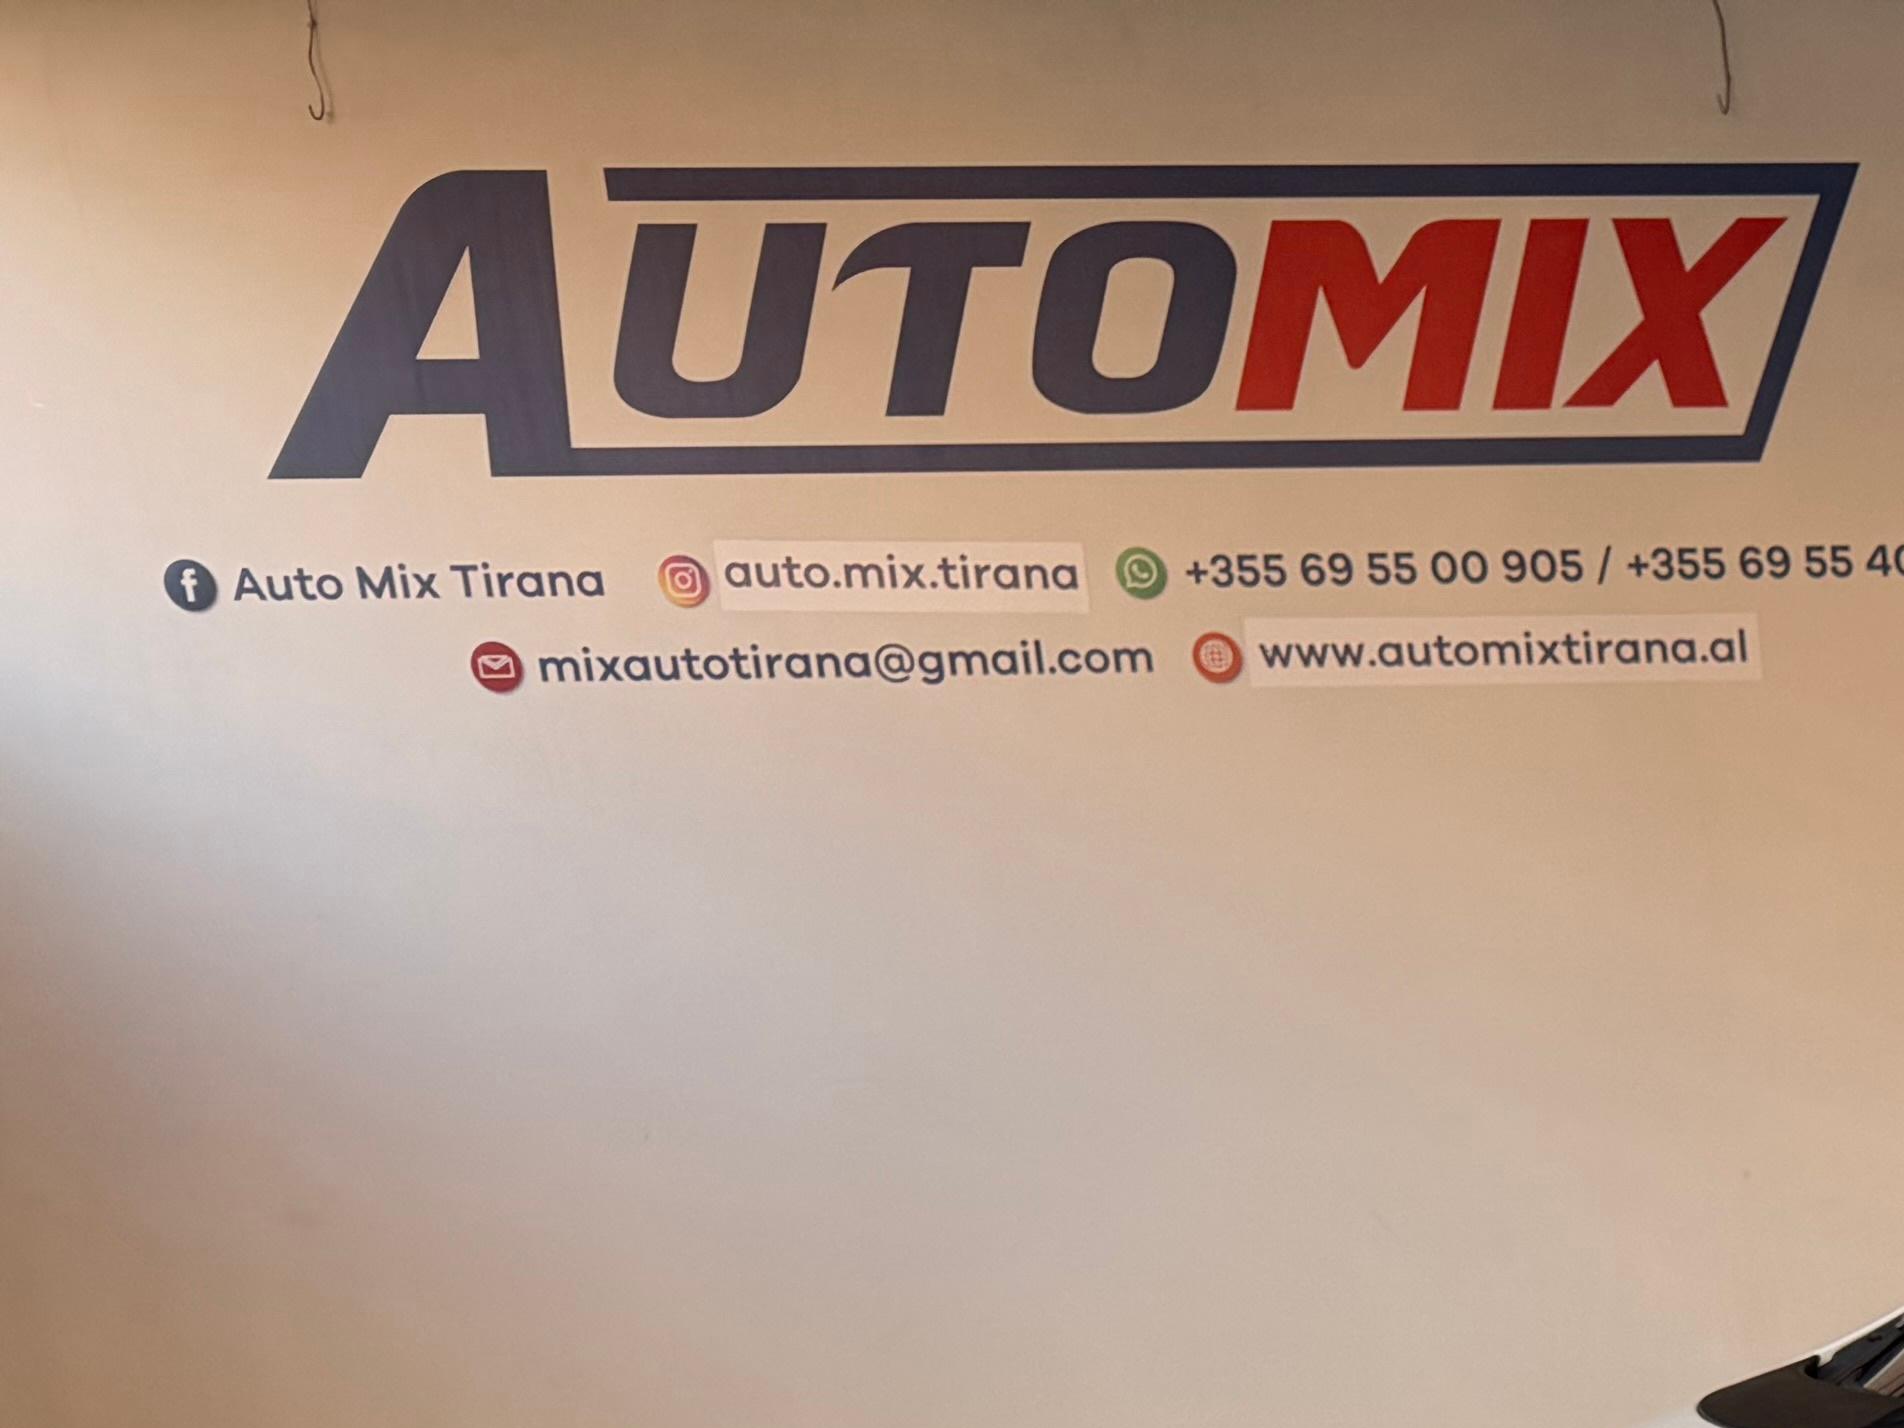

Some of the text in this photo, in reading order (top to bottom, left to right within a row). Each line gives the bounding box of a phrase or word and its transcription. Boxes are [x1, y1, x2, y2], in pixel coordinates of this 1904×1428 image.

[268, 168, 1788, 478] AUTOMIX
[234, 562, 605, 601] Auto Mix Tirana
[724, 553, 1079, 591] auto.mix.tirana
[1186, 553, 1287, 587] +355
[1300, 552, 1353, 587] 69
[1367, 551, 1417, 584] 55
[1431, 550, 1488, 584] 00
[1502, 549, 1583, 583] 905
[1597, 546, 1611, 585] /
[1628, 546, 1726, 581] +355
[1740, 546, 1791, 579] 69
[1804, 545, 1853, 577] 55
[538, 639, 1154, 685] mixautotirana@gmail.com
[1259, 629, 1748, 668] www.automixtirana.al
